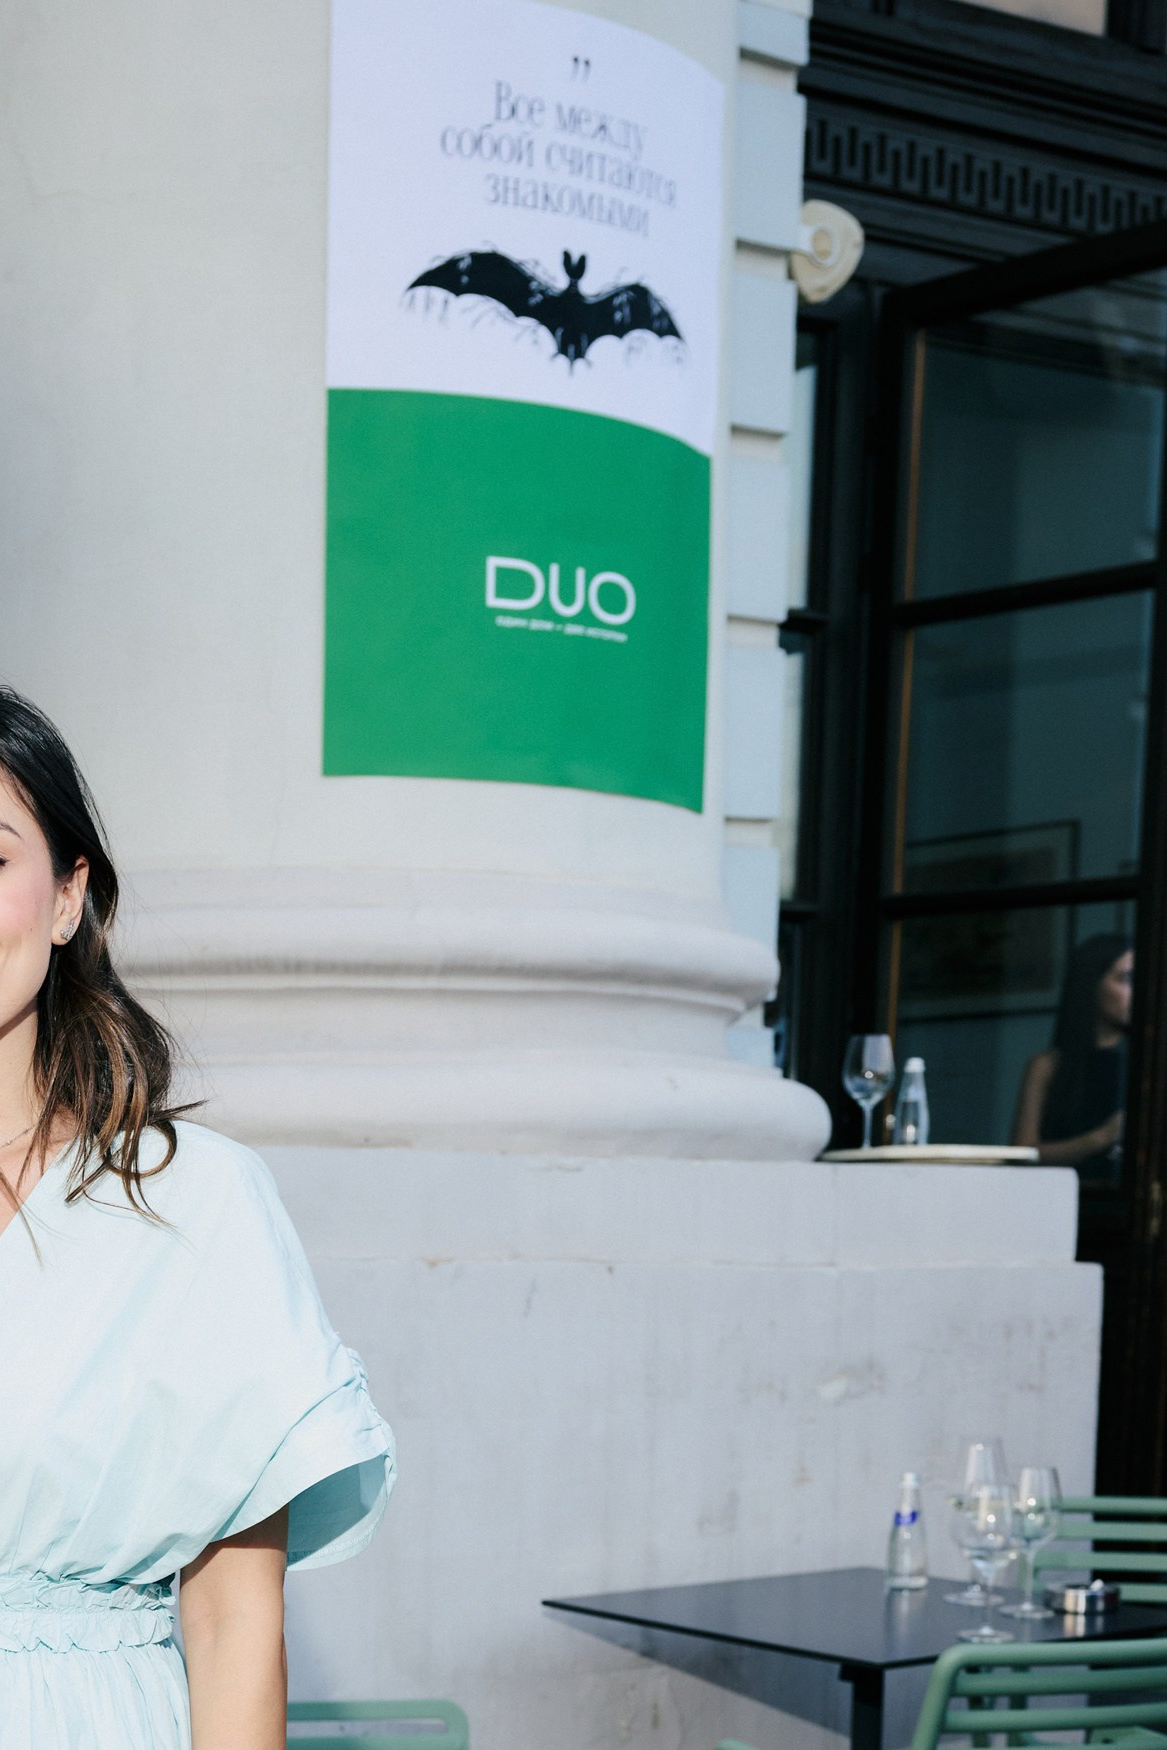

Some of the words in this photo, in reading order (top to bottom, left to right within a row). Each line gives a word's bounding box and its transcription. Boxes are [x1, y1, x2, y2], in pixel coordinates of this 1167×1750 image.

[440, 122, 535, 168] собой
[494, 80, 545, 129] Все
[555, 101, 648, 161] между
[484, 173, 650, 238] знакомыми
[485, 555, 636, 625] DUO
